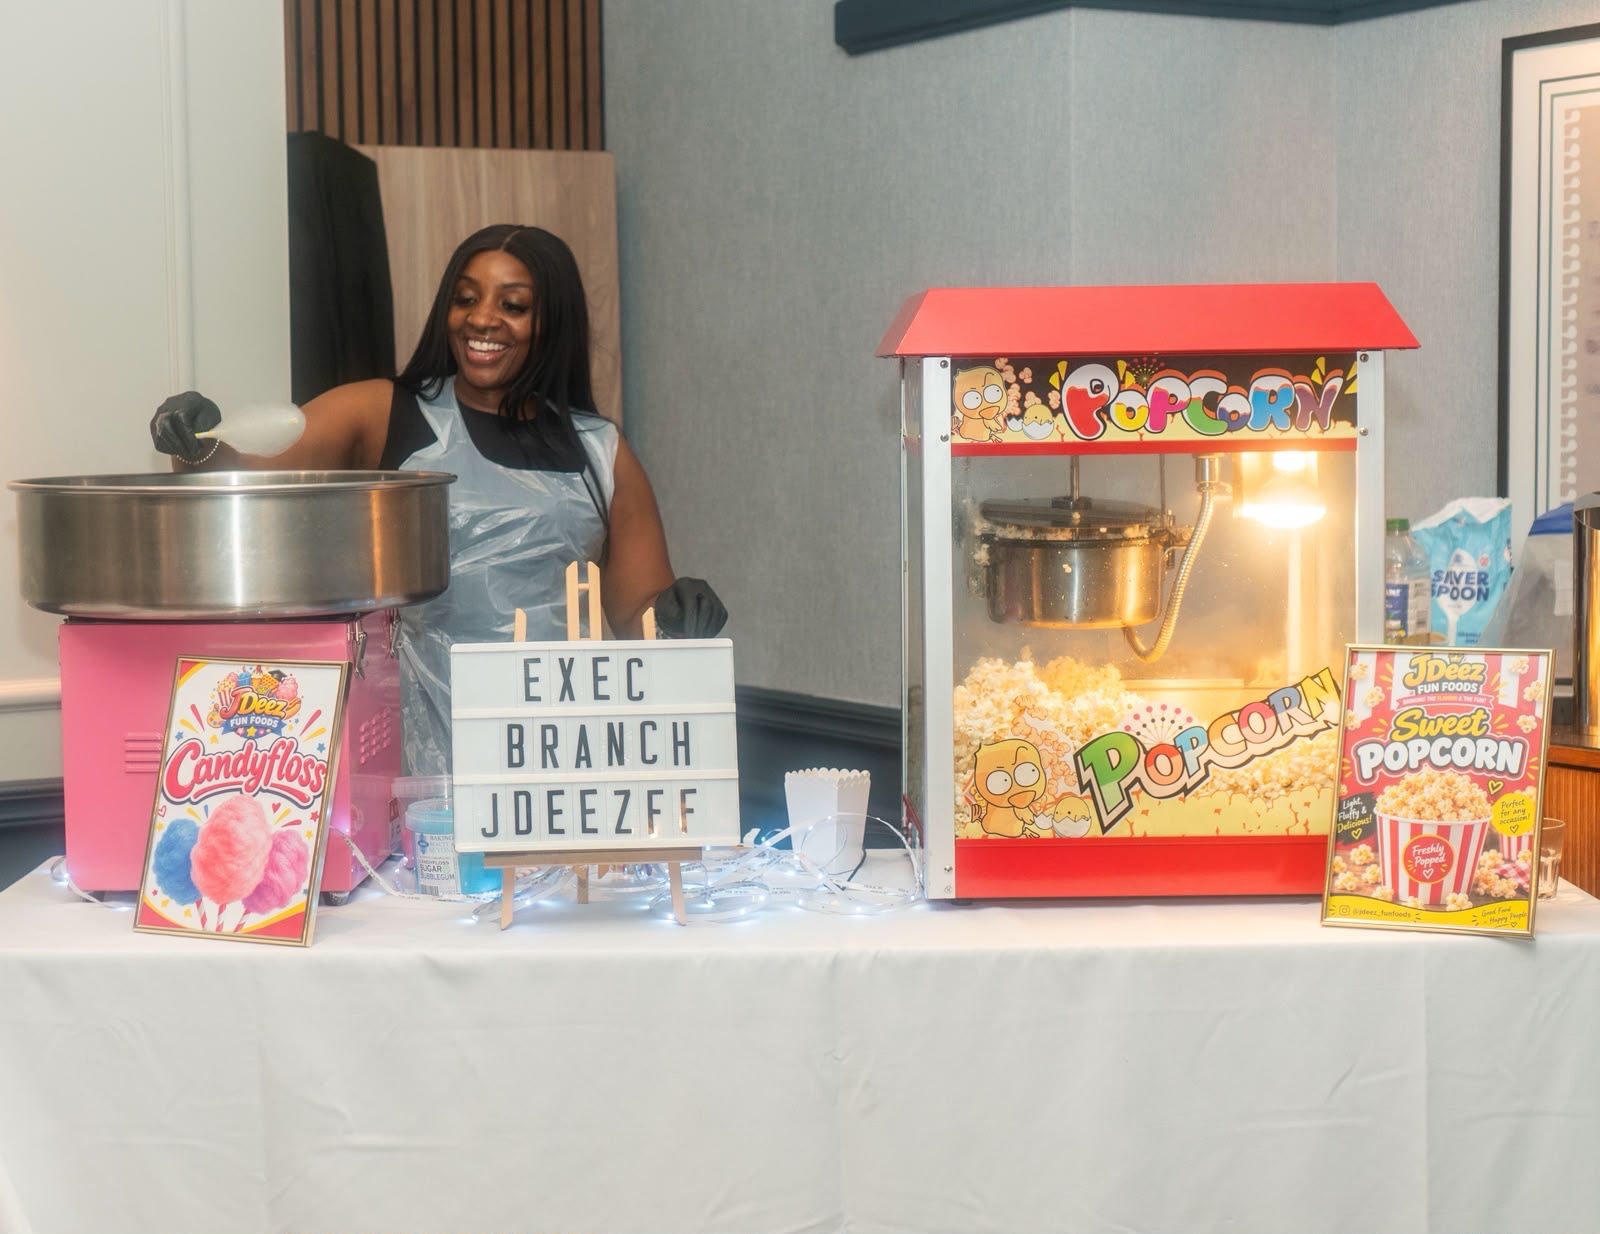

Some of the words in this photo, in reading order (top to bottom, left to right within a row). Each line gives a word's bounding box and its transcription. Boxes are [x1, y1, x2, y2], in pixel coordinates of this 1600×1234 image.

[1403, 653, 1486, 688] JDeez
[523, 657, 644, 702] EXEC
[1417, 684, 1440, 694] FUN
[1441, 682, 1479, 693] FOODS
[220, 687, 288, 719] JDeez
[230, 717, 247, 727] FUN
[250, 716, 279, 728] FOODS
[1391, 708, 1490, 741] Sweet
[507, 720, 691, 769] BRANCH
[1357, 738, 1523, 780] POPCORN
[163, 739, 327, 802] Candyfloss
[1501, 799, 1525, 808] Perfect
[481, 788, 697, 838] JDEEZFF
[1338, 808, 1360, 821] Fluffy
[1361, 806, 1368, 815] &
[1500, 809, 1510, 818] for
[1513, 808, 1526, 816] any
[1337, 814, 1372, 833] Delicious!
[1412, 843, 1445, 857] Freshly
[420, 864, 442, 872] SUGAR
[1414, 855, 1447, 867] Popped
[1482, 909, 1497, 917] Good
